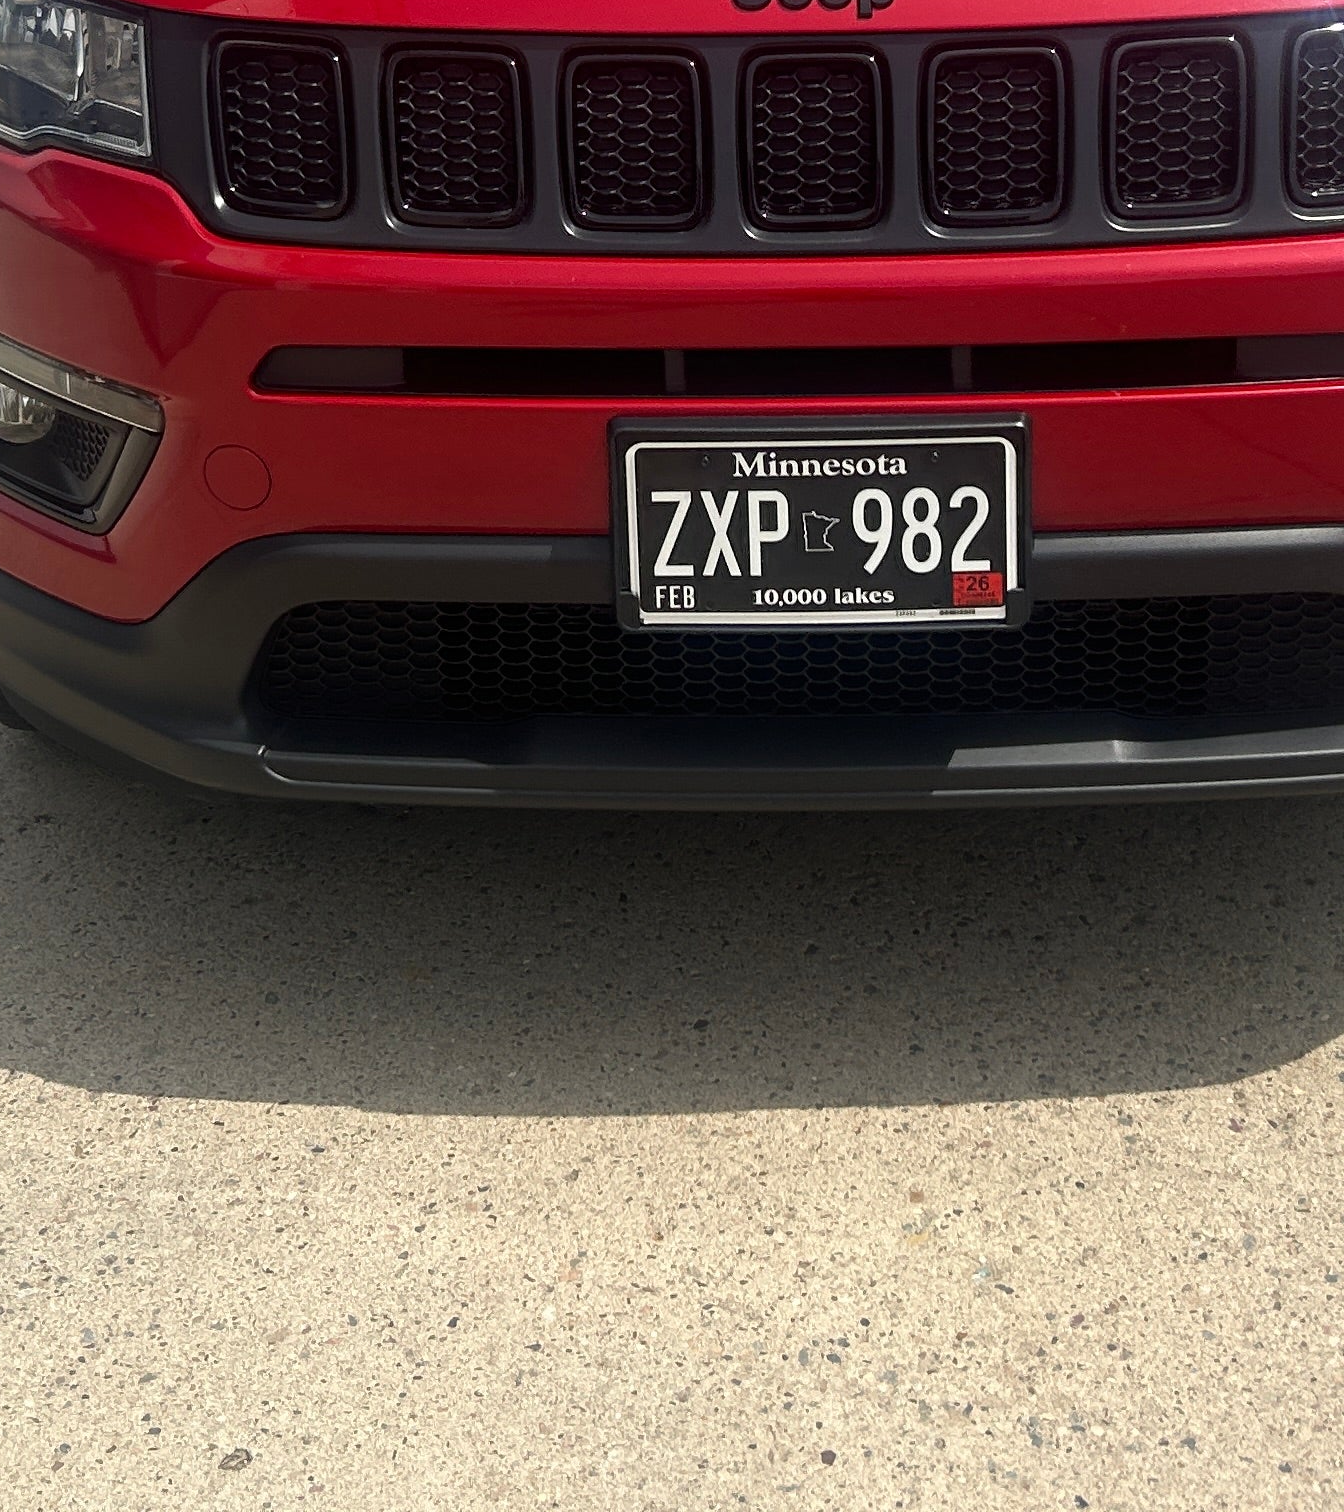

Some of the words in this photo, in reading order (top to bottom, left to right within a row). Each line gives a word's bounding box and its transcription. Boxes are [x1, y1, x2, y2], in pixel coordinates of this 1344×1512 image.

[731, 451, 908, 478] Minnesota
[651, 489, 789, 577] ZXP
[852, 486, 991, 575] 982
[966, 575, 990, 592] 26
[655, 585, 695, 609] FEB
[753, 588, 828, 607] 10,000
[834, 587, 895, 605] lakes
